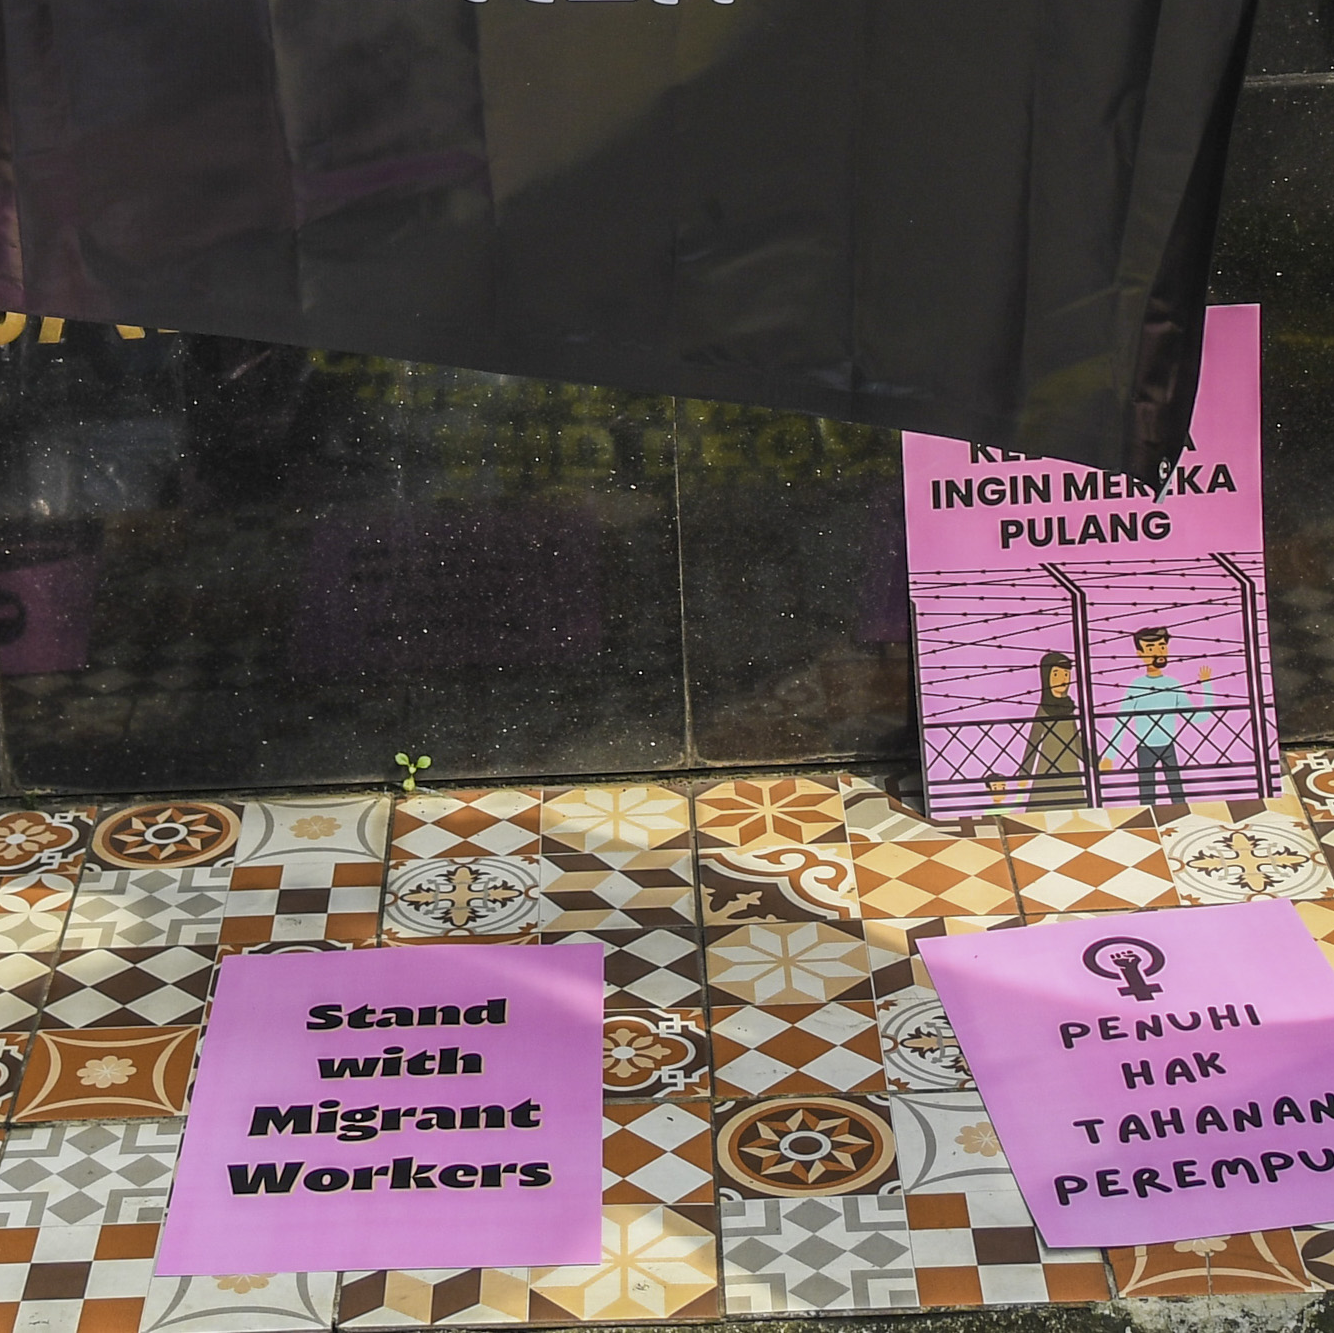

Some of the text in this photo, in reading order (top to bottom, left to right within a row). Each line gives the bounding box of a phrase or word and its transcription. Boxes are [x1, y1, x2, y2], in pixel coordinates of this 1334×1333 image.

[931, 464, 1238, 510] INGIN MERKA
[1000, 510, 1171, 550] PULANG
[306, 997, 507, 1031] Stand
[1059, 1004, 1261, 1049] PENUHI
[317, 1045, 483, 1079] with
[1121, 1052, 1227, 1090] HAK
[247, 1097, 541, 1142] Migrant
[227, 1156, 552, 1195] Workers
